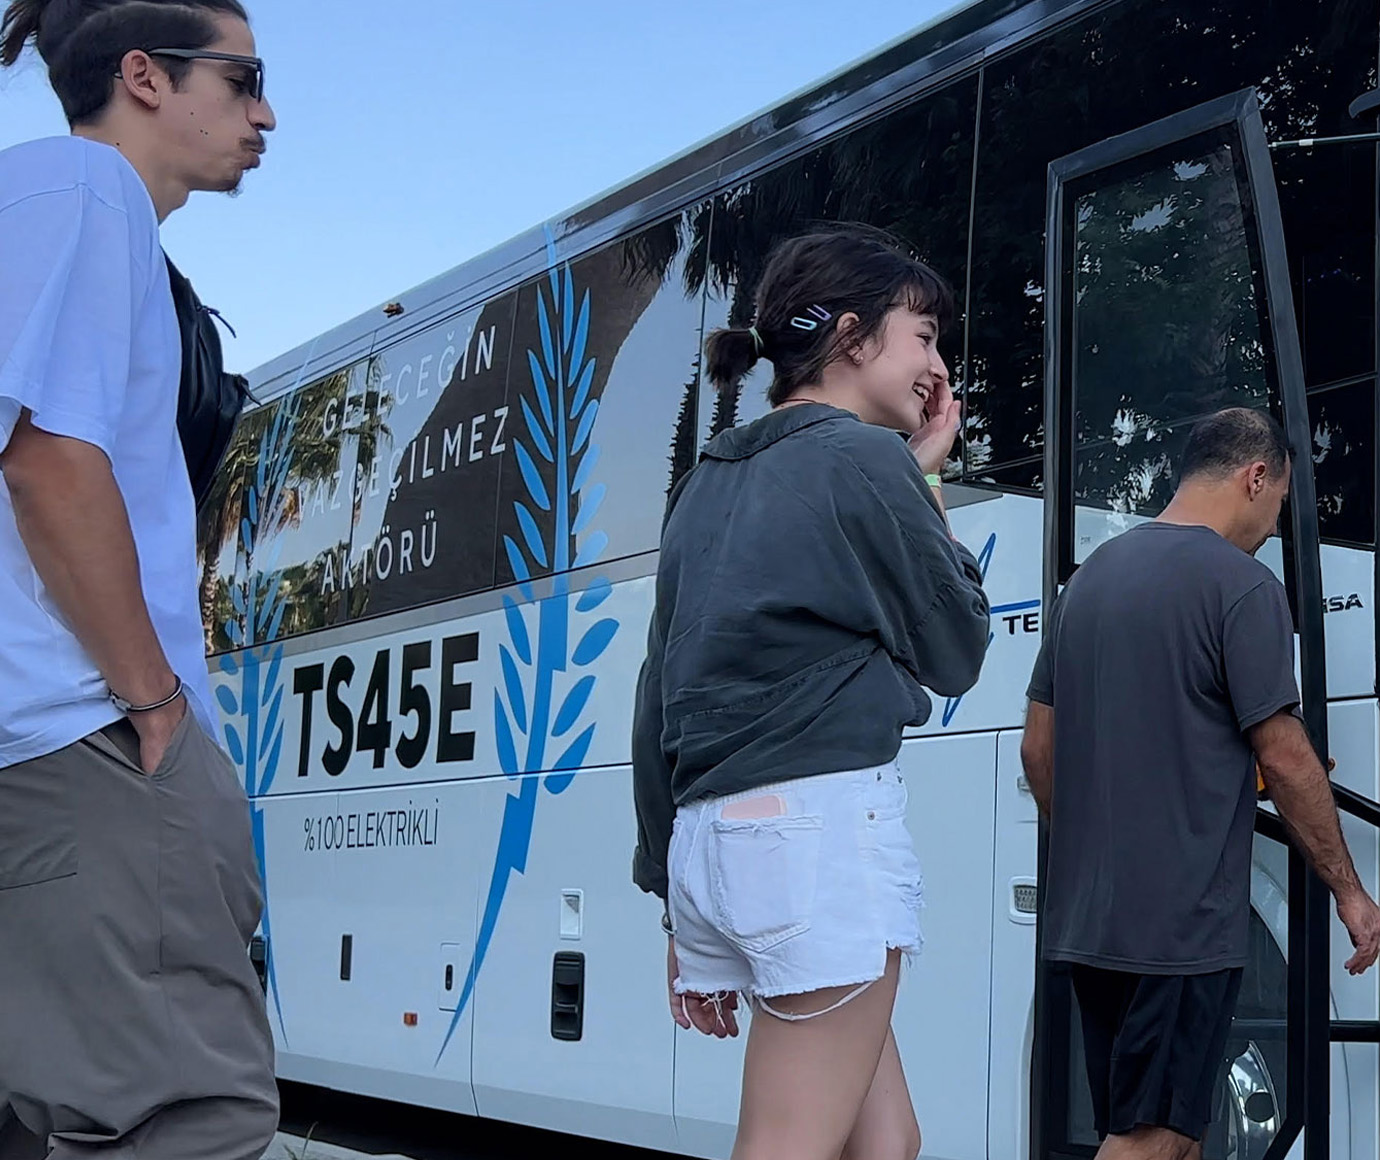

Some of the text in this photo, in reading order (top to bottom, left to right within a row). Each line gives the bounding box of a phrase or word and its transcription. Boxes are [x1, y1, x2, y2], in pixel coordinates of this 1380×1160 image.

[322, 325, 496, 438] GELECEĞİN
[320, 509, 437, 596] AKTÖRÜ
[292, 631, 480, 778] TS45E
[304, 798, 439, 852] %100 ELEKTRİKLİ
